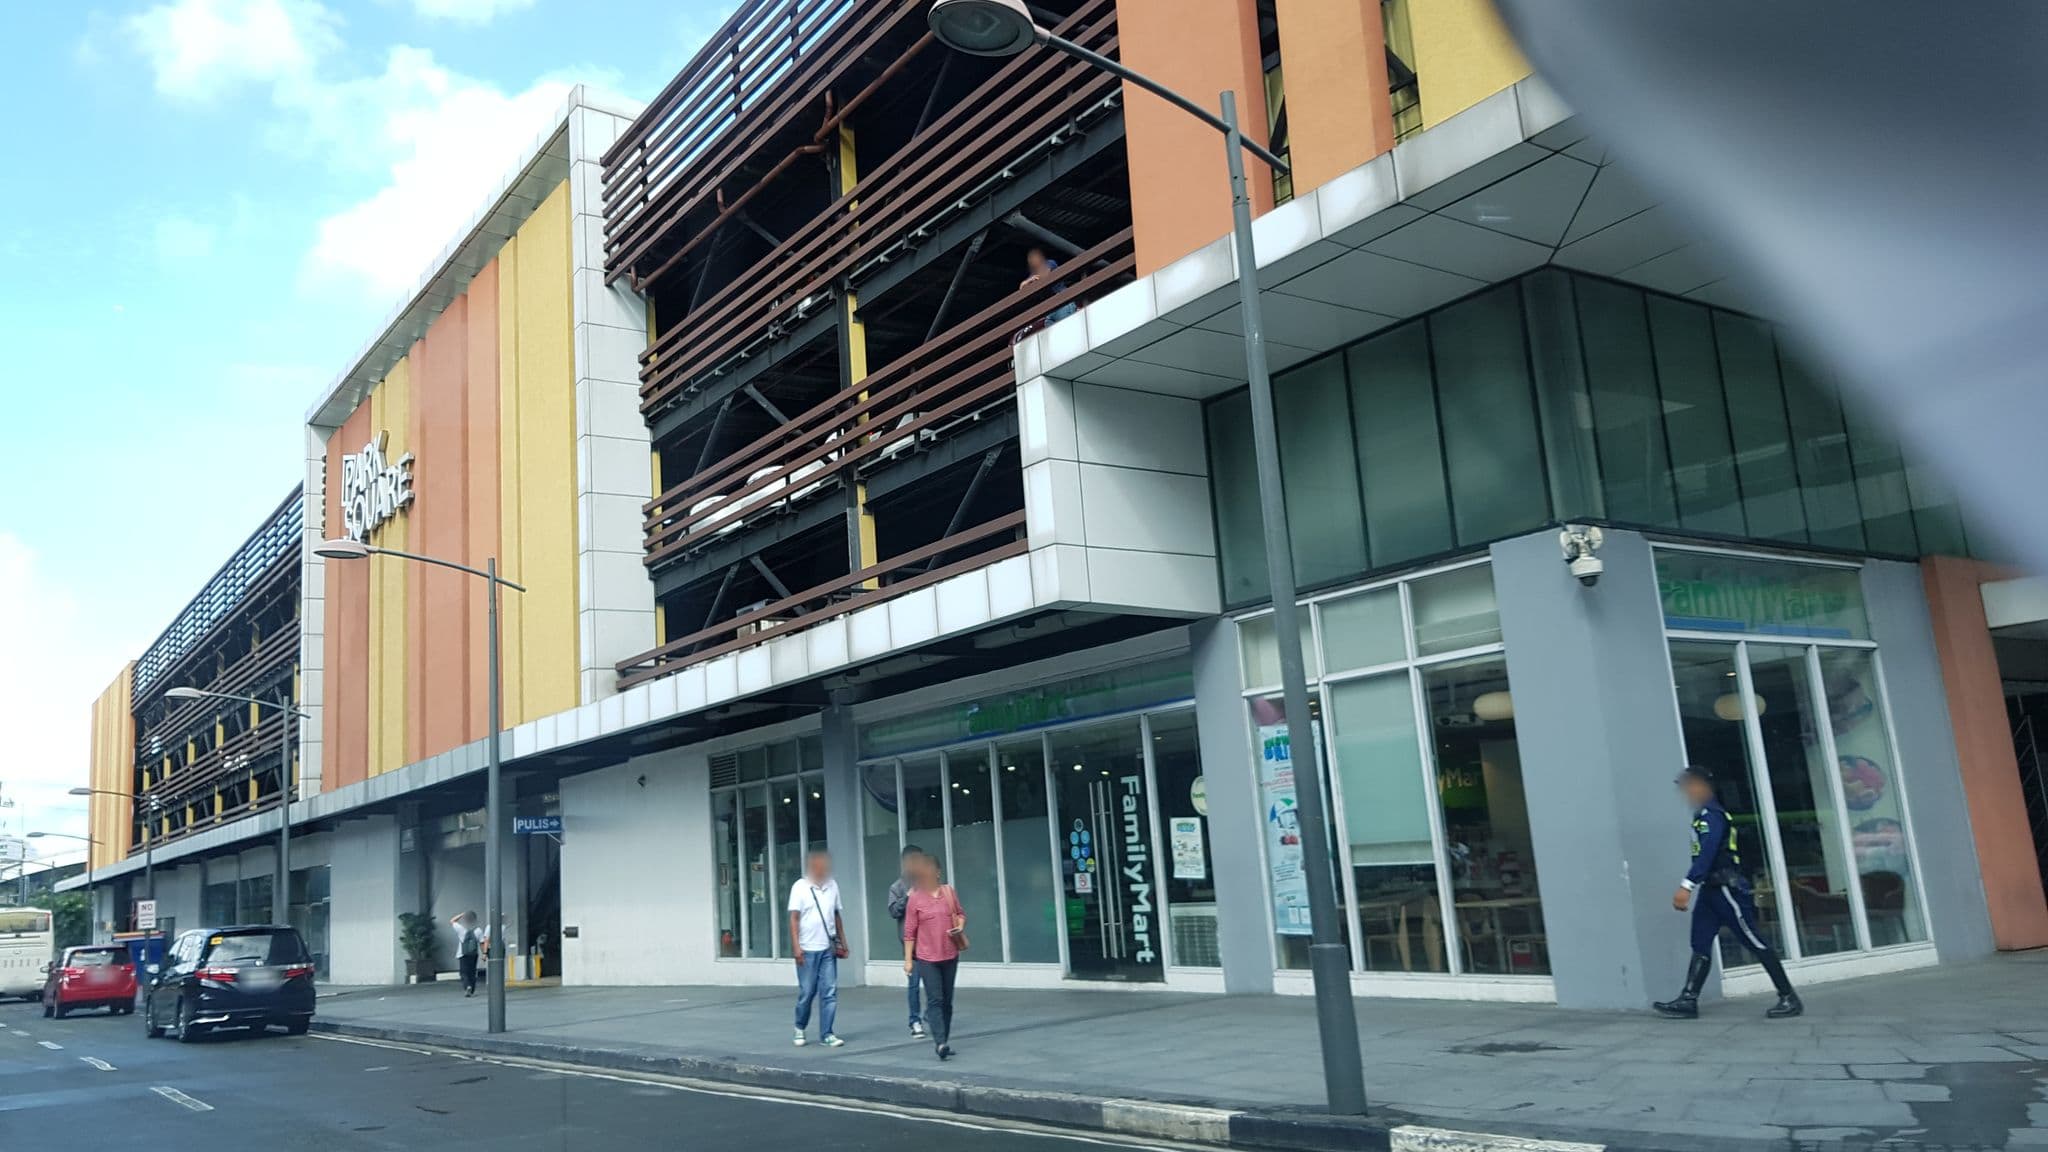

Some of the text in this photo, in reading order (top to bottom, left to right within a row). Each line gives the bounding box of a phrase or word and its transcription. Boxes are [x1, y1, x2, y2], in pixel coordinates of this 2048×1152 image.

[344, 452, 415, 541] SQUARE
[345, 430, 389, 506] PARK
[517, 818, 550, 831] PULIS
[141, 903, 153, 911] NO
[1120, 775, 1155, 964] FamilyMart
